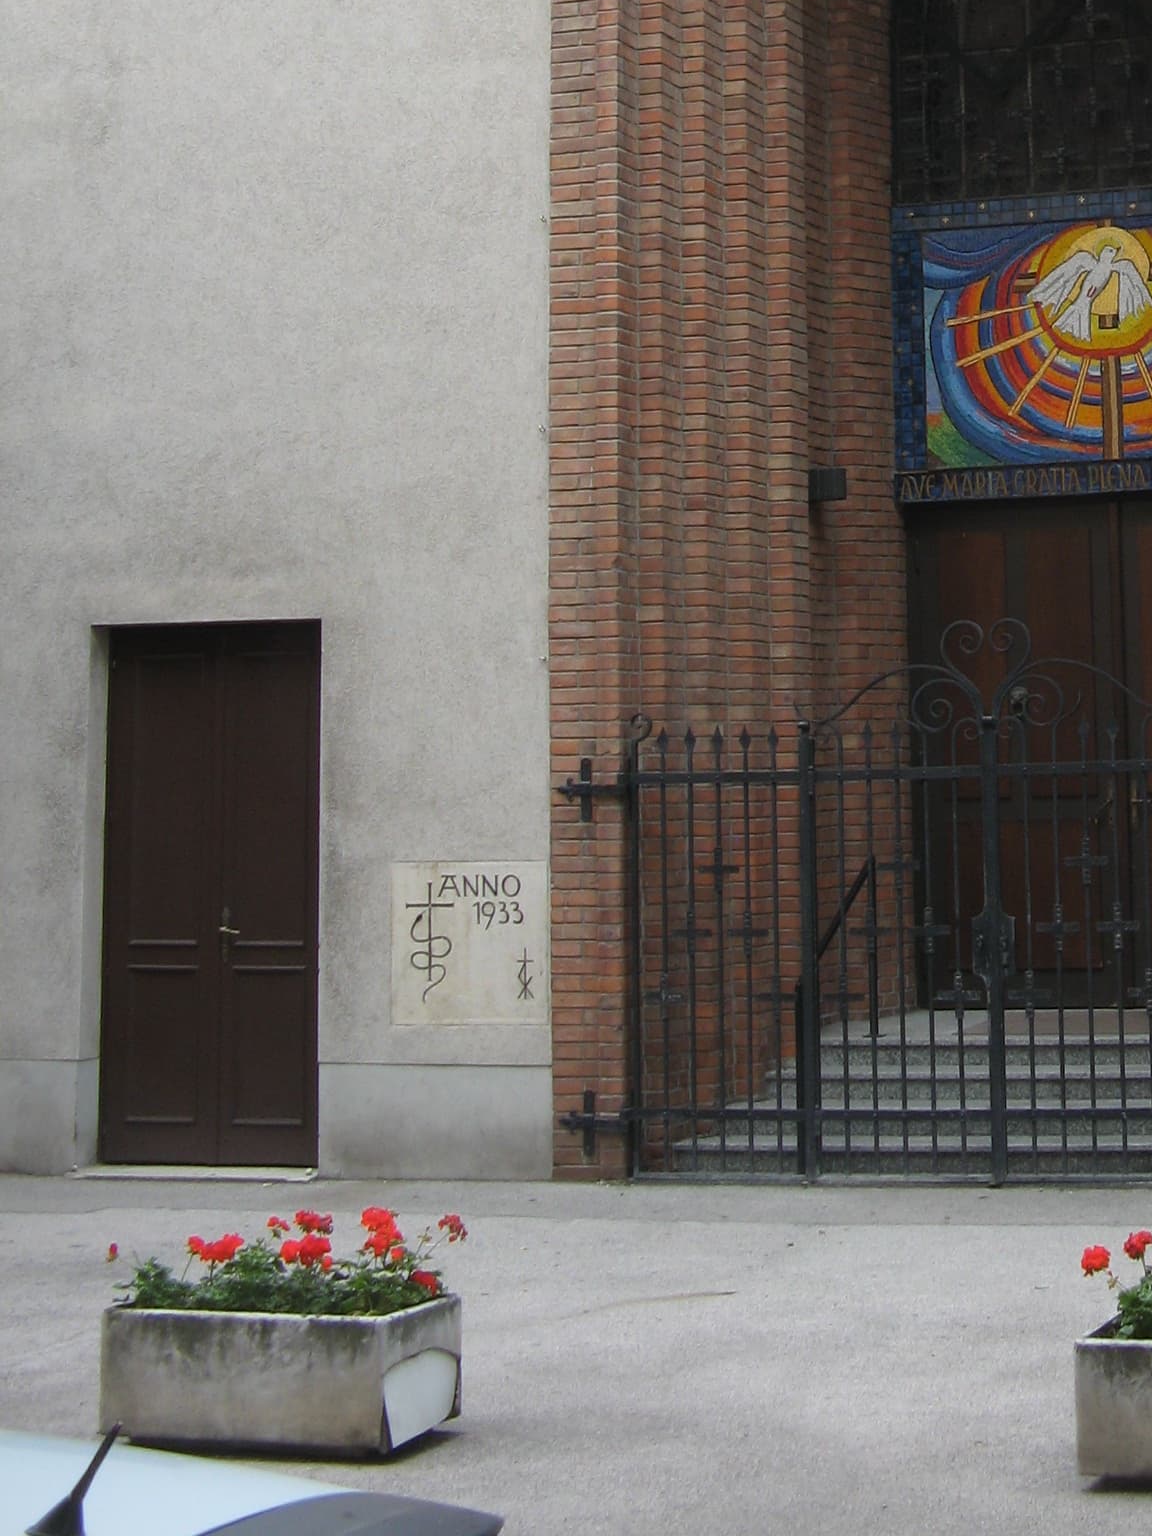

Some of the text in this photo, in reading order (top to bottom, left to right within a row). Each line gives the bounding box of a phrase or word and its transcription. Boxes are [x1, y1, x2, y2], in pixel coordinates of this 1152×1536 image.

[900, 474, 935, 501] AVE
[942, 469, 1008, 498] MARIA
[1014, 466, 1081, 496] GRATIA
[1088, 463, 1146, 492] PLENA
[437, 874, 521, 898] ANNO
[472, 901, 524, 931] 1933
